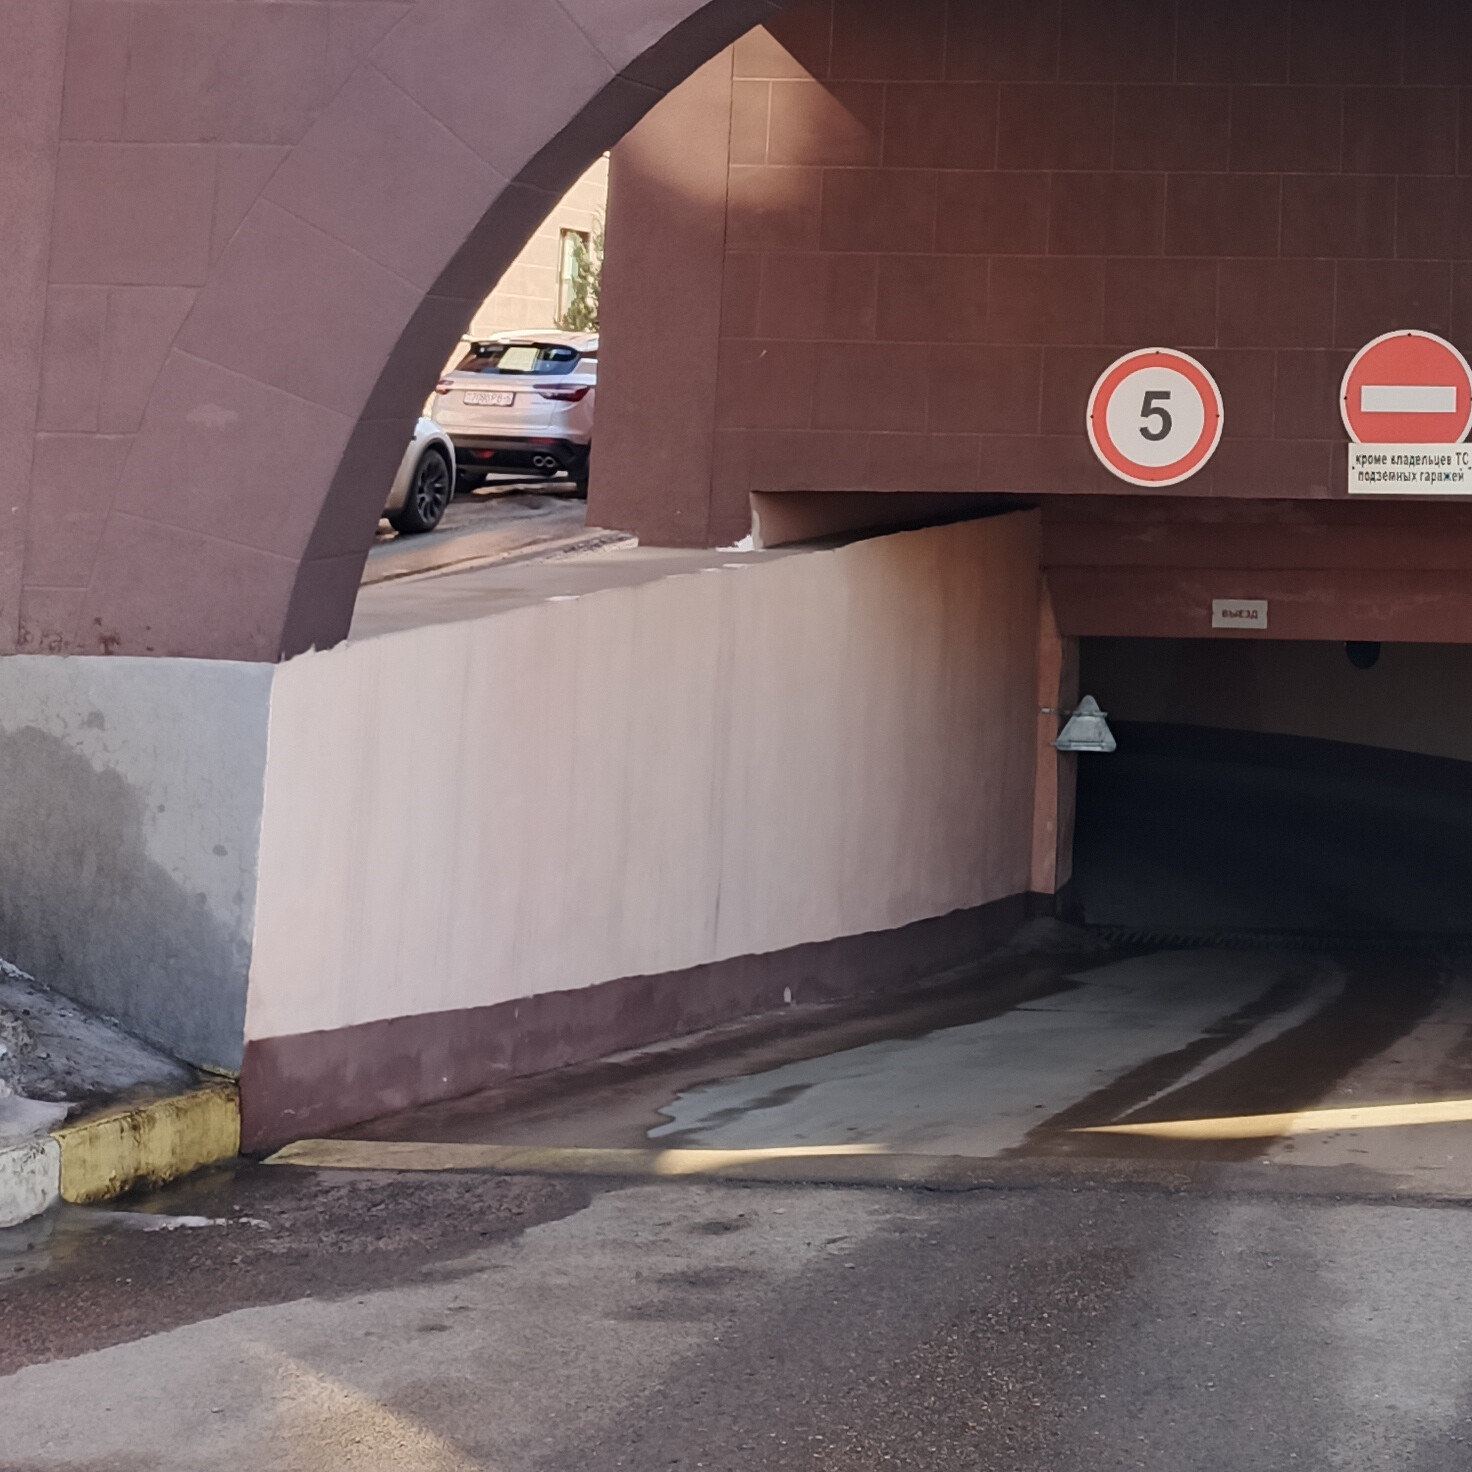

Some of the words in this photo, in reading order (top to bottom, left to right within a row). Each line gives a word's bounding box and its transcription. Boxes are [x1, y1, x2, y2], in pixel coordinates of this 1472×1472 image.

[1139, 390, 1173, 441] 5
[1355, 454, 1388, 467] кроме
[1391, 455, 1452, 467] владельцев
[1455, 452, 1469, 465] ТС
[1358, 471, 1417, 483] подземных
[1420, 468, 1464, 484] гаражей
